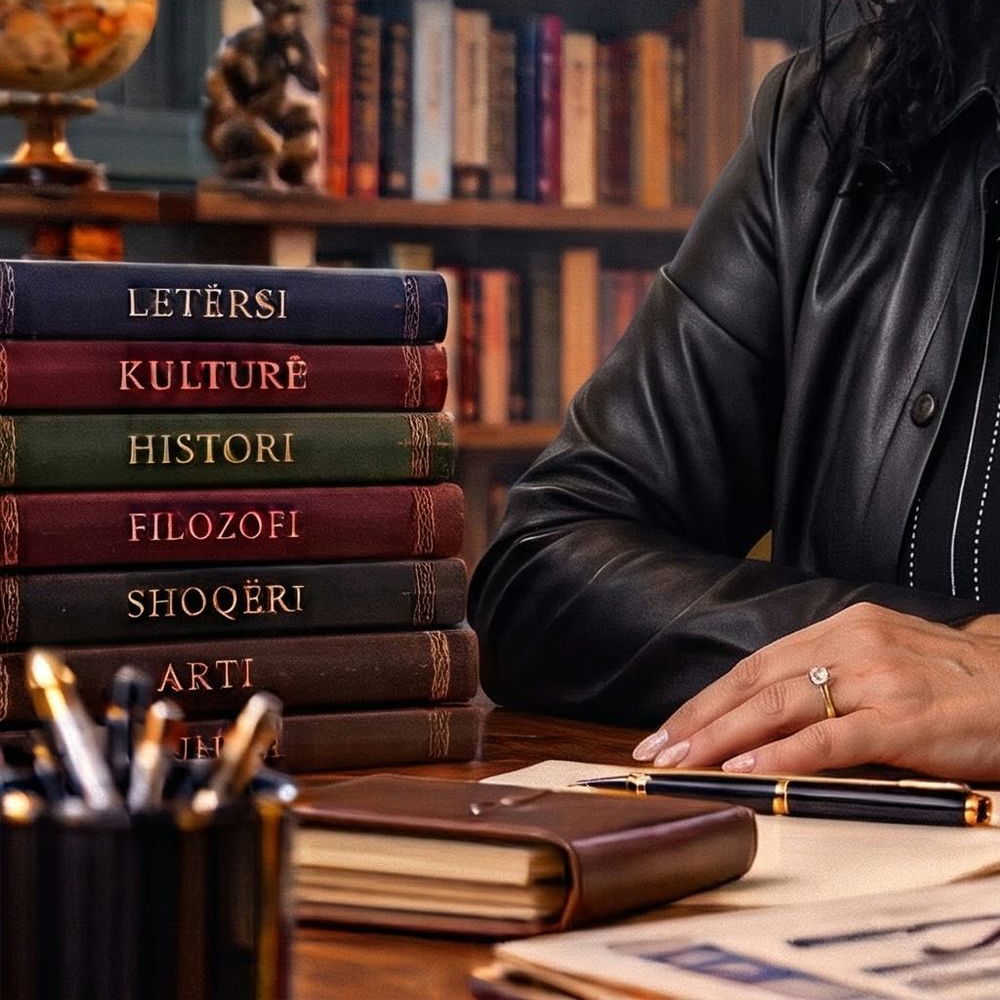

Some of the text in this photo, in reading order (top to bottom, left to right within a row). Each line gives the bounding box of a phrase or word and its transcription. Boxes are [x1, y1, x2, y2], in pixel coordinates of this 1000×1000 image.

[127, 283, 288, 319] LETËRSI
[127, 432, 294, 466] HISTORI
[128, 510, 300, 542] FILOZOFI
[127, 578, 305, 621] SHOQËRI
[156, 657, 254, 693] ARTI
